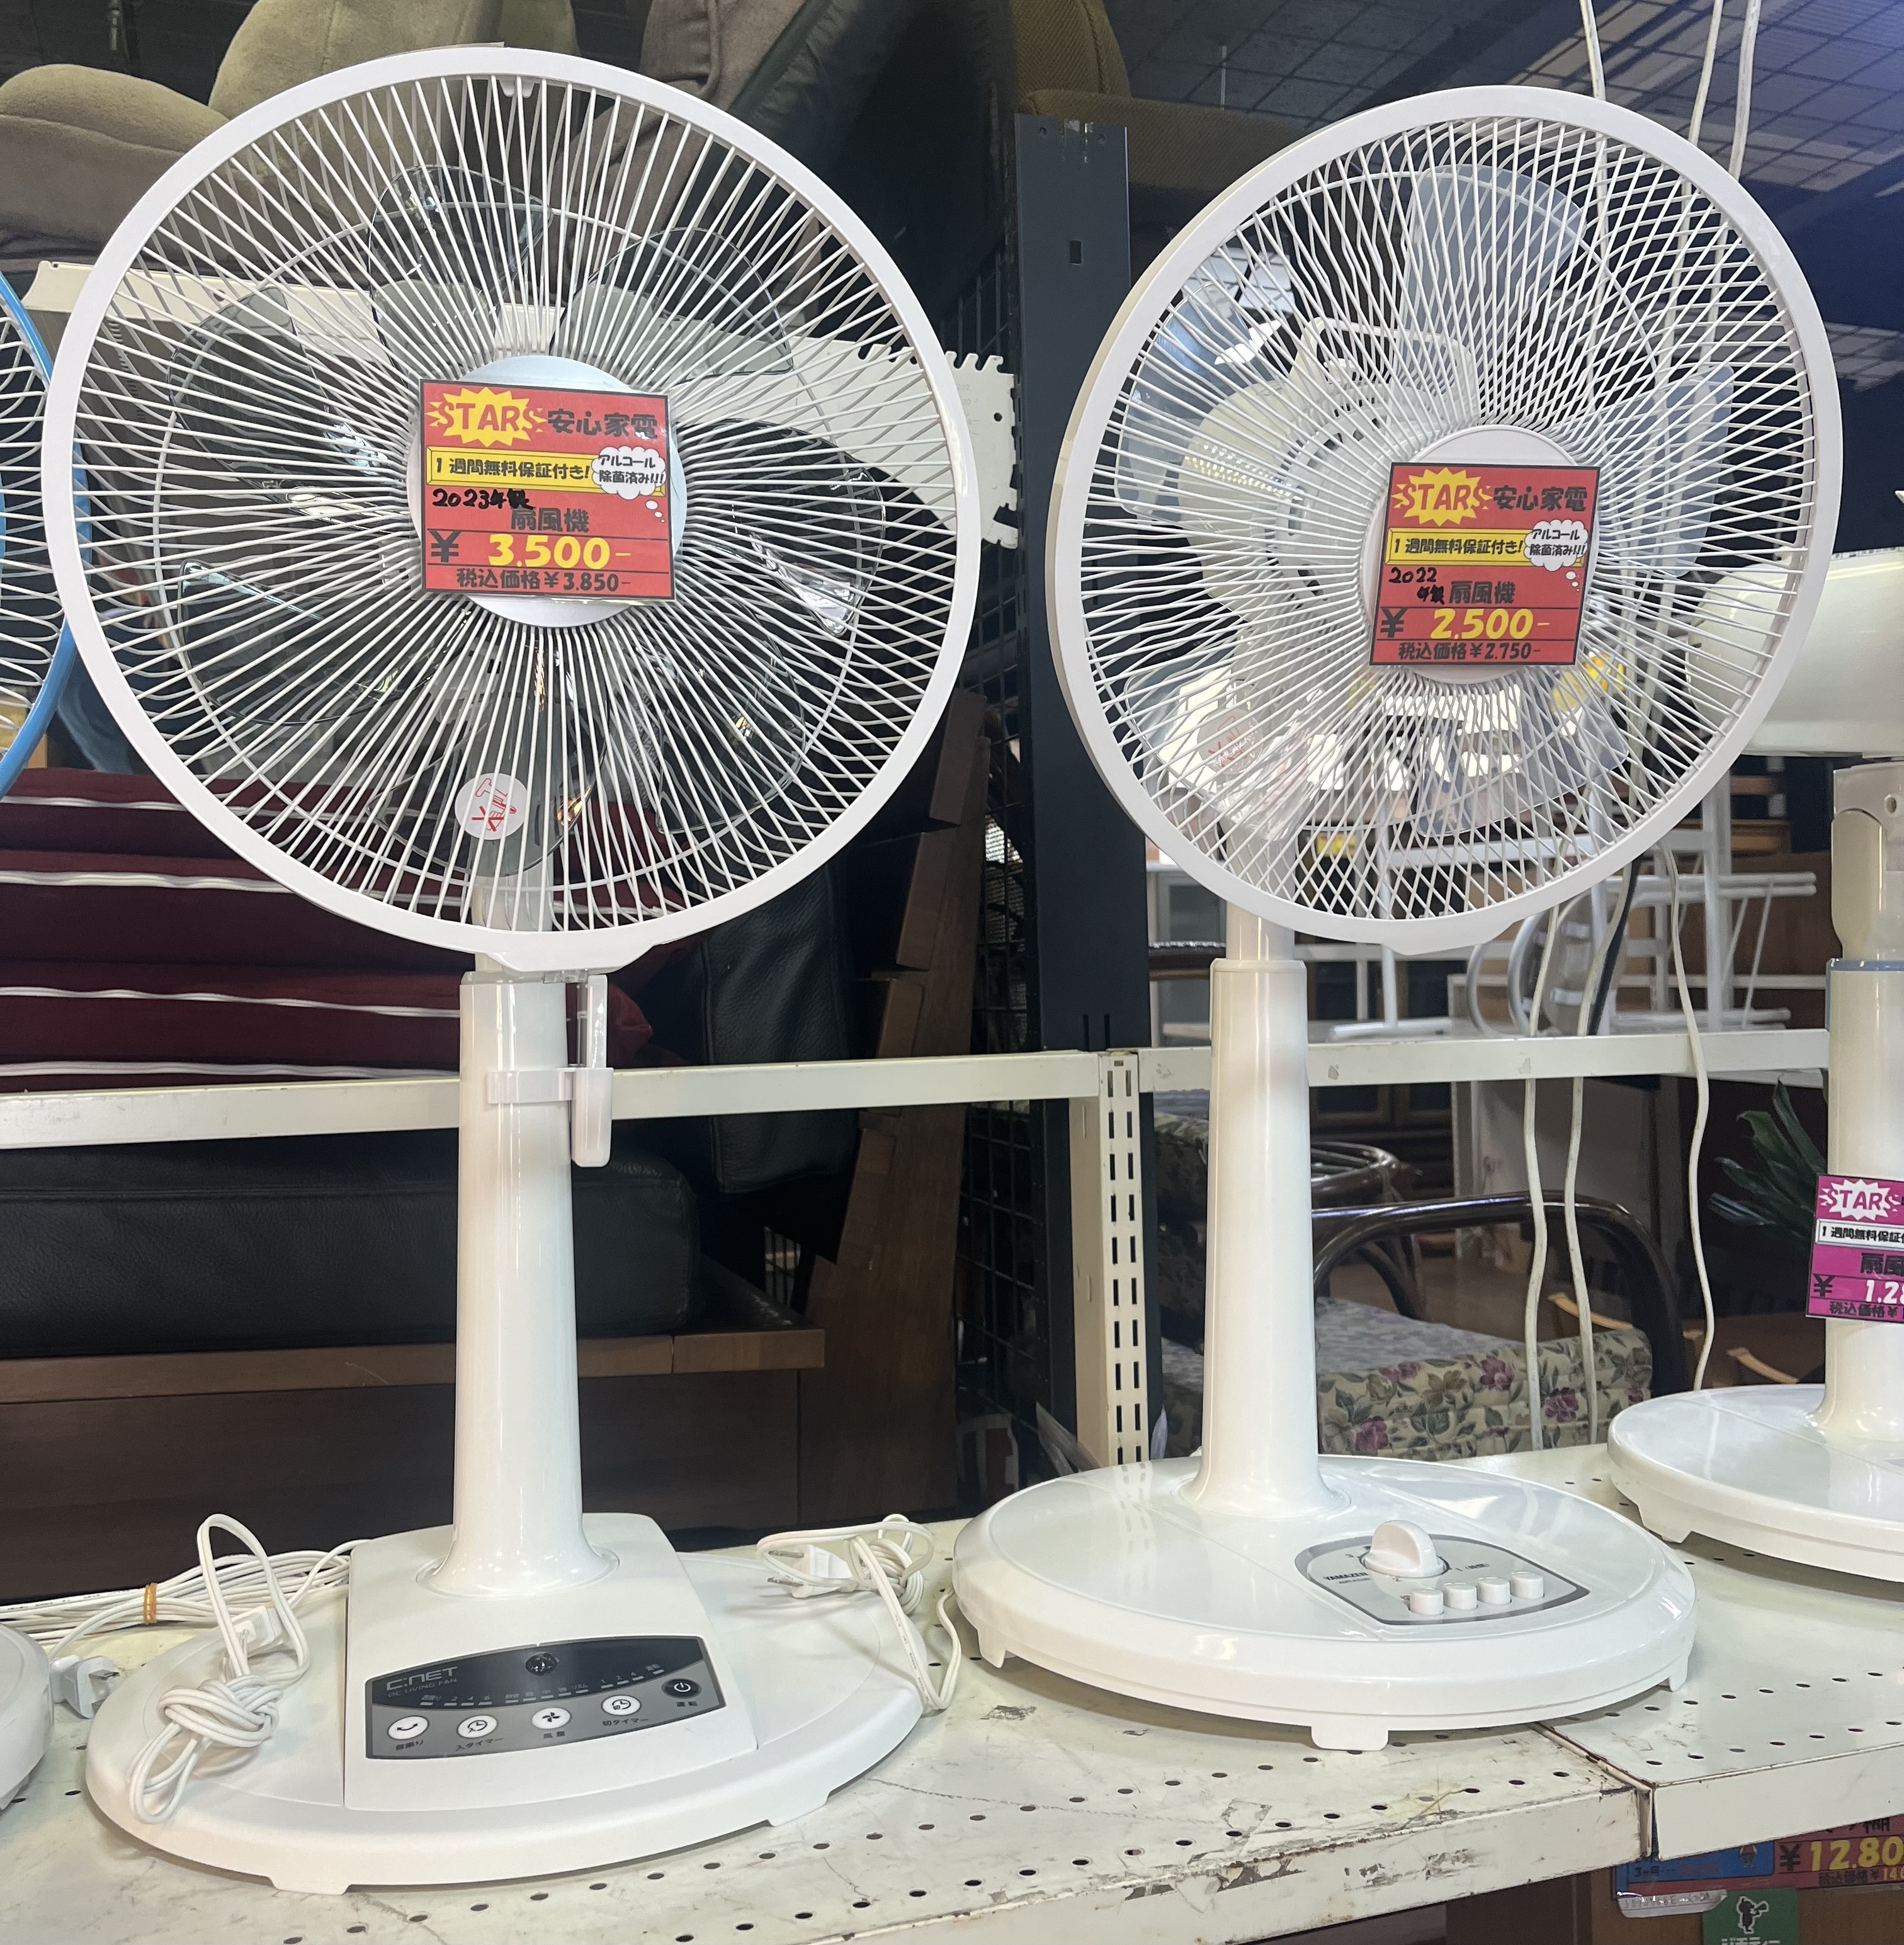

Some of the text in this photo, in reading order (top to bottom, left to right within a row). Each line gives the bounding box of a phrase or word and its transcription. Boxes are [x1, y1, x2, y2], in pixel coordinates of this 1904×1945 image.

[437, 402, 537, 433] STARS
[547, 408, 658, 439] 安心家電
[599, 453, 656, 469] アルコール
[1400, 484, 1488, 511] STARS
[1493, 485, 1587, 512] 安心家電
[510, 507, 589, 533] 扇風機
[1531, 529, 1580, 541] アルコール
[1388, 567, 1437, 584] 2022
[1449, 581, 1516, 604] 扇風機
[1826, 1188, 1896, 1211] STARS
[405, 1682, 435, 1694] LIVING
[603, 1718, 649, 1727] 切タイマー
